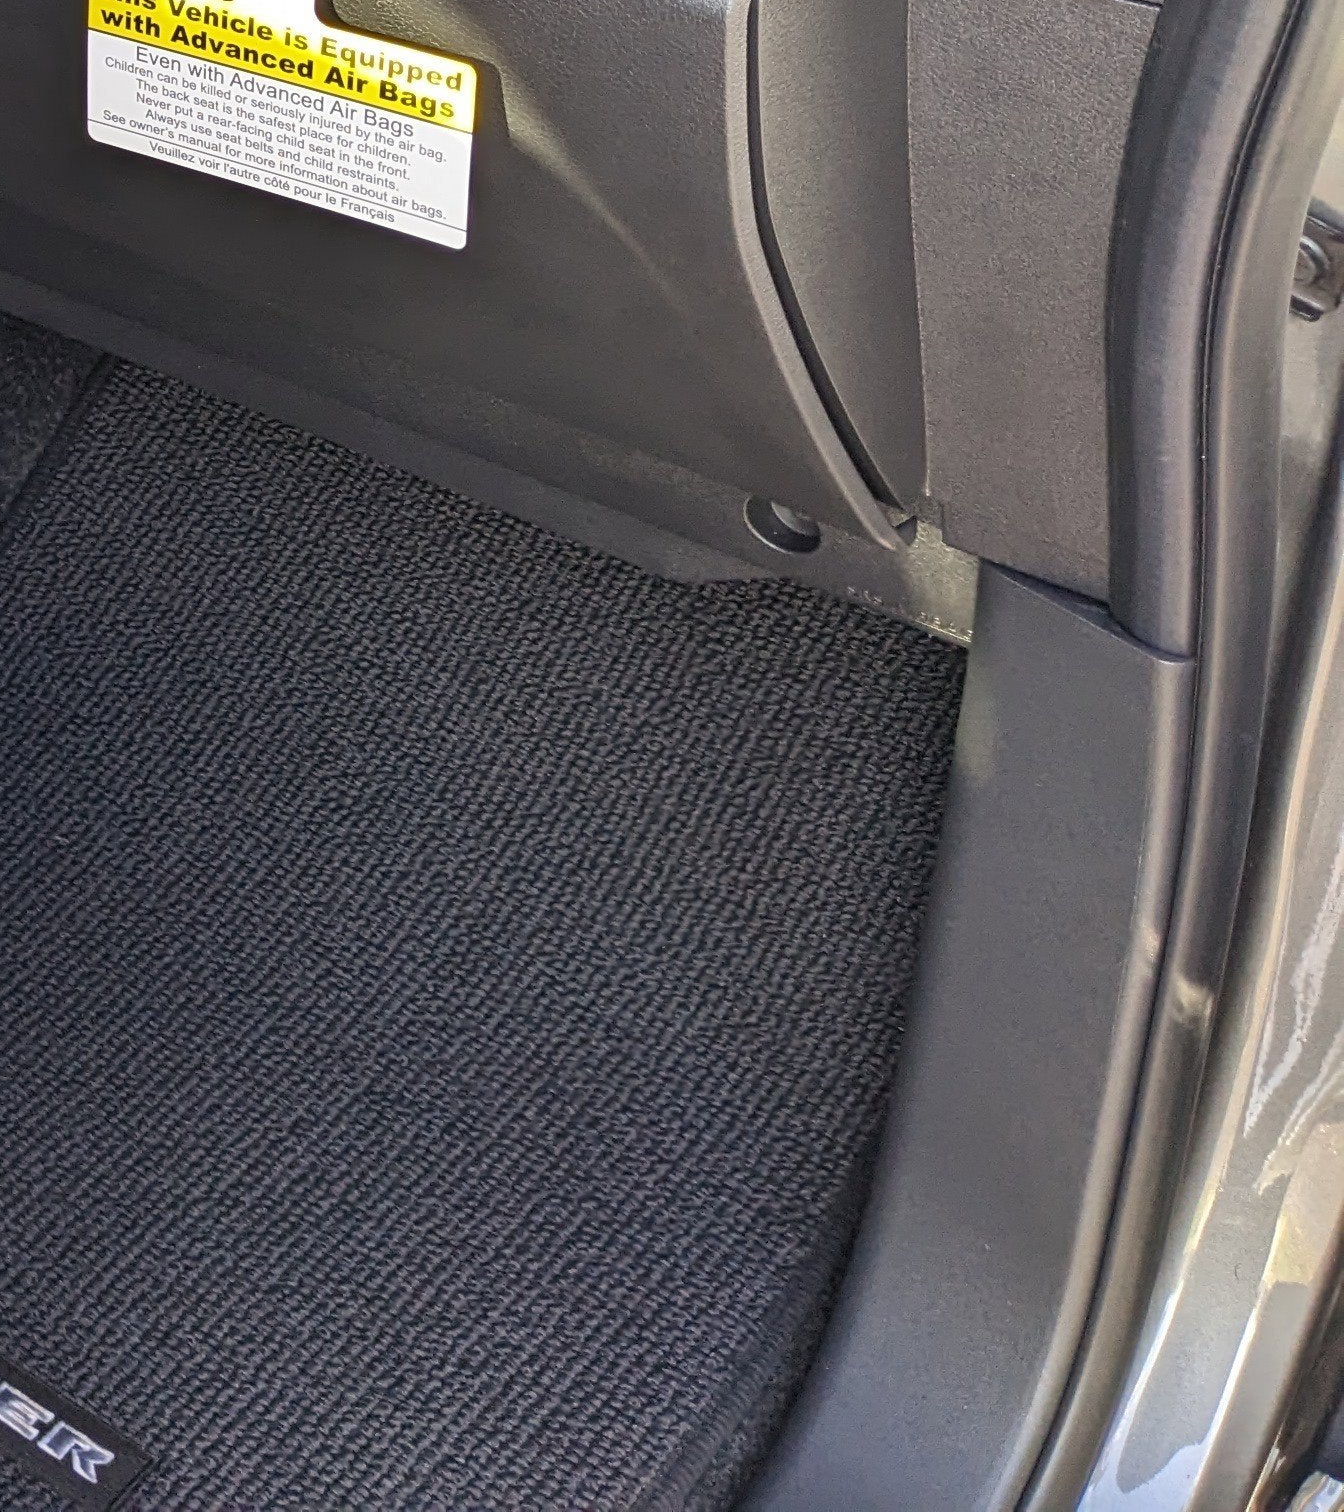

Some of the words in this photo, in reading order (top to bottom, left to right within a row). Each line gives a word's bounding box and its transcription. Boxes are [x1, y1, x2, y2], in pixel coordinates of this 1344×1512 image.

[100, 8, 160, 38] with
[169, 24, 313, 79] Advanced
[323, 65, 368, 93] Air
[378, 79, 454, 118] Bags
[135, 45, 181, 72] Even
[186, 62, 224, 84] with
[228, 71, 324, 112] Advanced
[328, 99, 357, 120] Air
[363, 107, 414, 138] Bags
[283, 26, 308, 50] is
[319, 36, 462, 91] Equipped
[104, 55, 153, 79] Children
[156, 72, 178, 86] can
[181, 76, 197, 91] be
[199, 81, 231, 100] killed
[234, 93, 248, 105] or
[250, 98, 306, 123] seriously
[308, 111, 352, 134] injured
[354, 124, 371, 141] by
[373, 131, 395, 147] the
[397, 139, 415, 152] air
[418, 143, 447, 163] bag.
[135, 77, 159, 94] The
[161, 84, 190, 103] back
[192, 96, 219, 111] seat
[222, 101, 233, 115] is
[235, 106, 255, 121] the
[258, 114, 296, 133] safest
[298, 125, 333, 143] place
[336, 134, 354, 149] for
[356, 142, 411, 166] children.
[135, 91, 171, 111] Never
[173, 104, 193, 118] put
[195, 111, 204, 121] a
[207, 113, 272, 142] rear-facing
[275, 132, 305, 149] child
[308, 142, 335, 159] seat
[338, 149, 350, 163] in
[353, 153, 374, 169] the
[376, 160, 410, 180] front.
[144, 108, 187, 129] Always
[190, 122, 212, 136] use
[214, 129, 242, 145] seat
[244, 135, 274, 154] belts
[277, 147, 300, 162] and
[303, 155, 333, 172] child
[336, 165, 399, 192] restraints.
[102, 108, 126, 125] See
[128, 118, 174, 139] owner's
[177, 132, 222, 153] manual
[224, 144, 242, 158] for
[244, 151, 276, 168] more
[278, 159, 348, 190] information
[350, 183, 388, 202] about
[390, 194, 408, 207] air
[410, 198, 446, 220] bags.
[148, 139, 195, 164] Veuillez
[197, 156, 220, 170] voir
[223, 161, 261, 182] l'autre
[263, 176, 290, 191] côté
[293, 184, 322, 200] pour
[324, 192, 337, 205] le
[340, 196, 395, 223] Français
